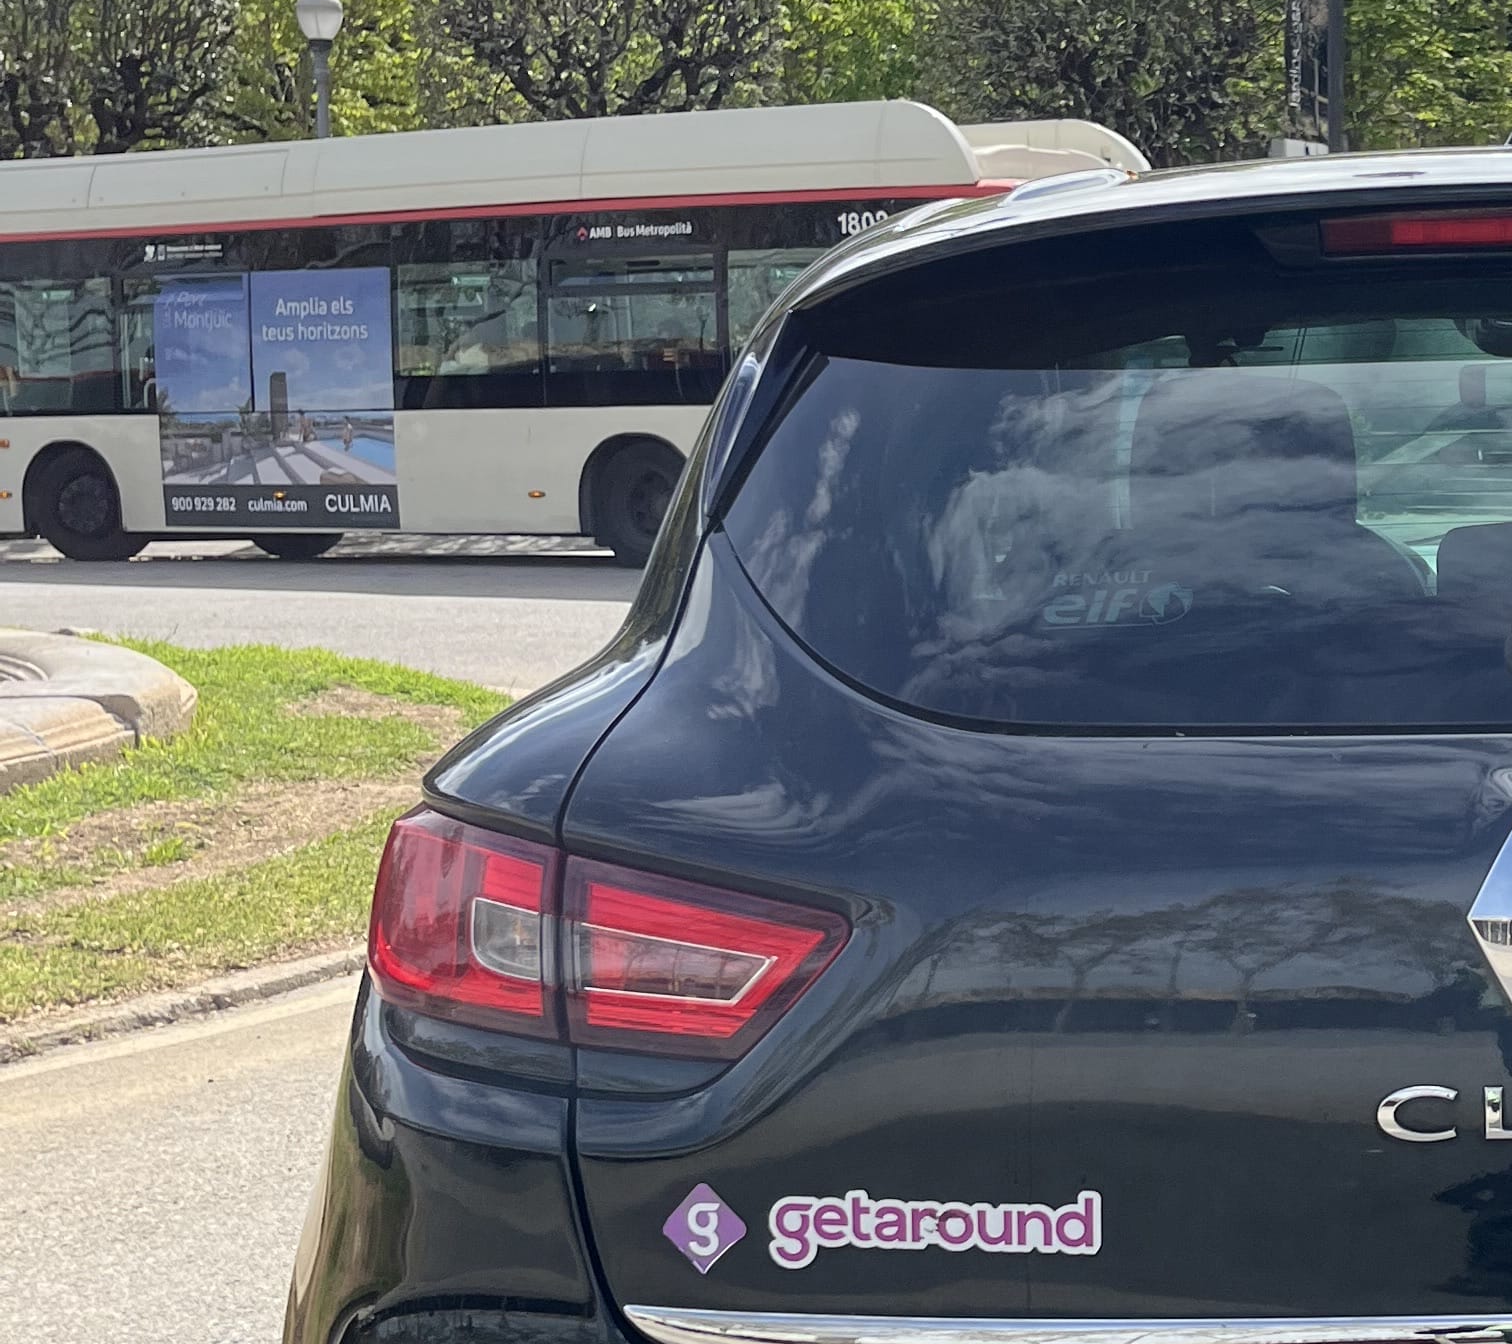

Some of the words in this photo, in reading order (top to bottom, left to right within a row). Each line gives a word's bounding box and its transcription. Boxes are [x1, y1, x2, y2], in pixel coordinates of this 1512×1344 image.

[589, 226, 612, 239] AMB
[617, 225, 635, 238] Bus
[275, 297, 328, 320] Amplia
[331, 296, 354, 315] els
[262, 324, 295, 341] teus
[298, 321, 369, 340] horitzons
[171, 496, 193, 511] 900
[194, 496, 214, 511] 929
[216, 496, 236, 511] 282
[248, 497, 307, 512] culmia.com
[325, 494, 392, 513] CULMIA
[1053, 570, 1153, 587] RENAULT
[1043, 589, 1139, 624] elf
[775, 1197, 1095, 1262] getaround
